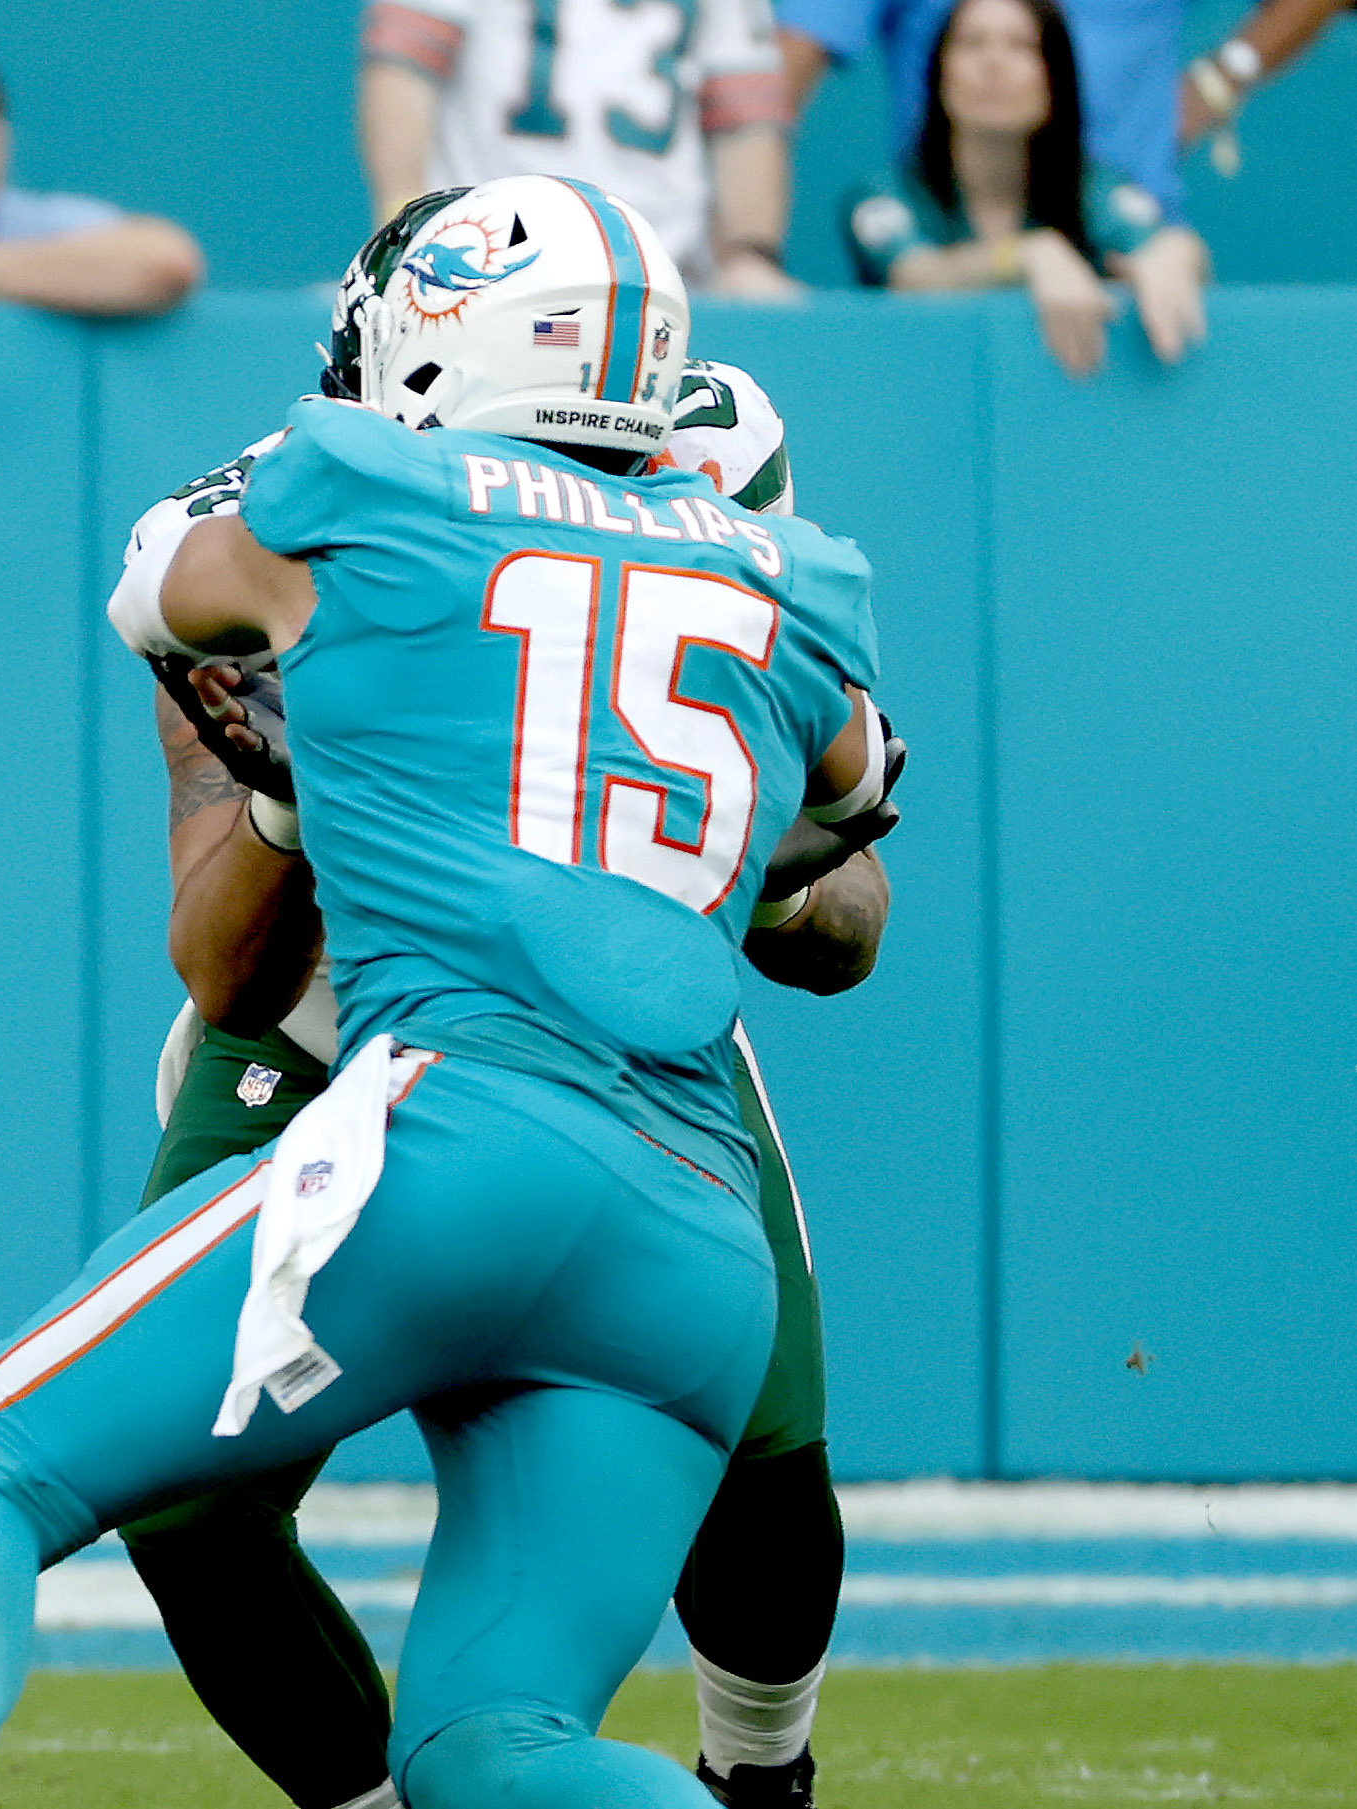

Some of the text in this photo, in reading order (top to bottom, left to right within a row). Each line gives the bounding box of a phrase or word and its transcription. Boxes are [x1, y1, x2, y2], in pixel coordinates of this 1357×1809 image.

[505, 0, 699, 155] 13
[536, 405, 611, 429] INSPIRE
[463, 453, 782, 578] PHILLIPS
[479, 548, 779, 916] 15
